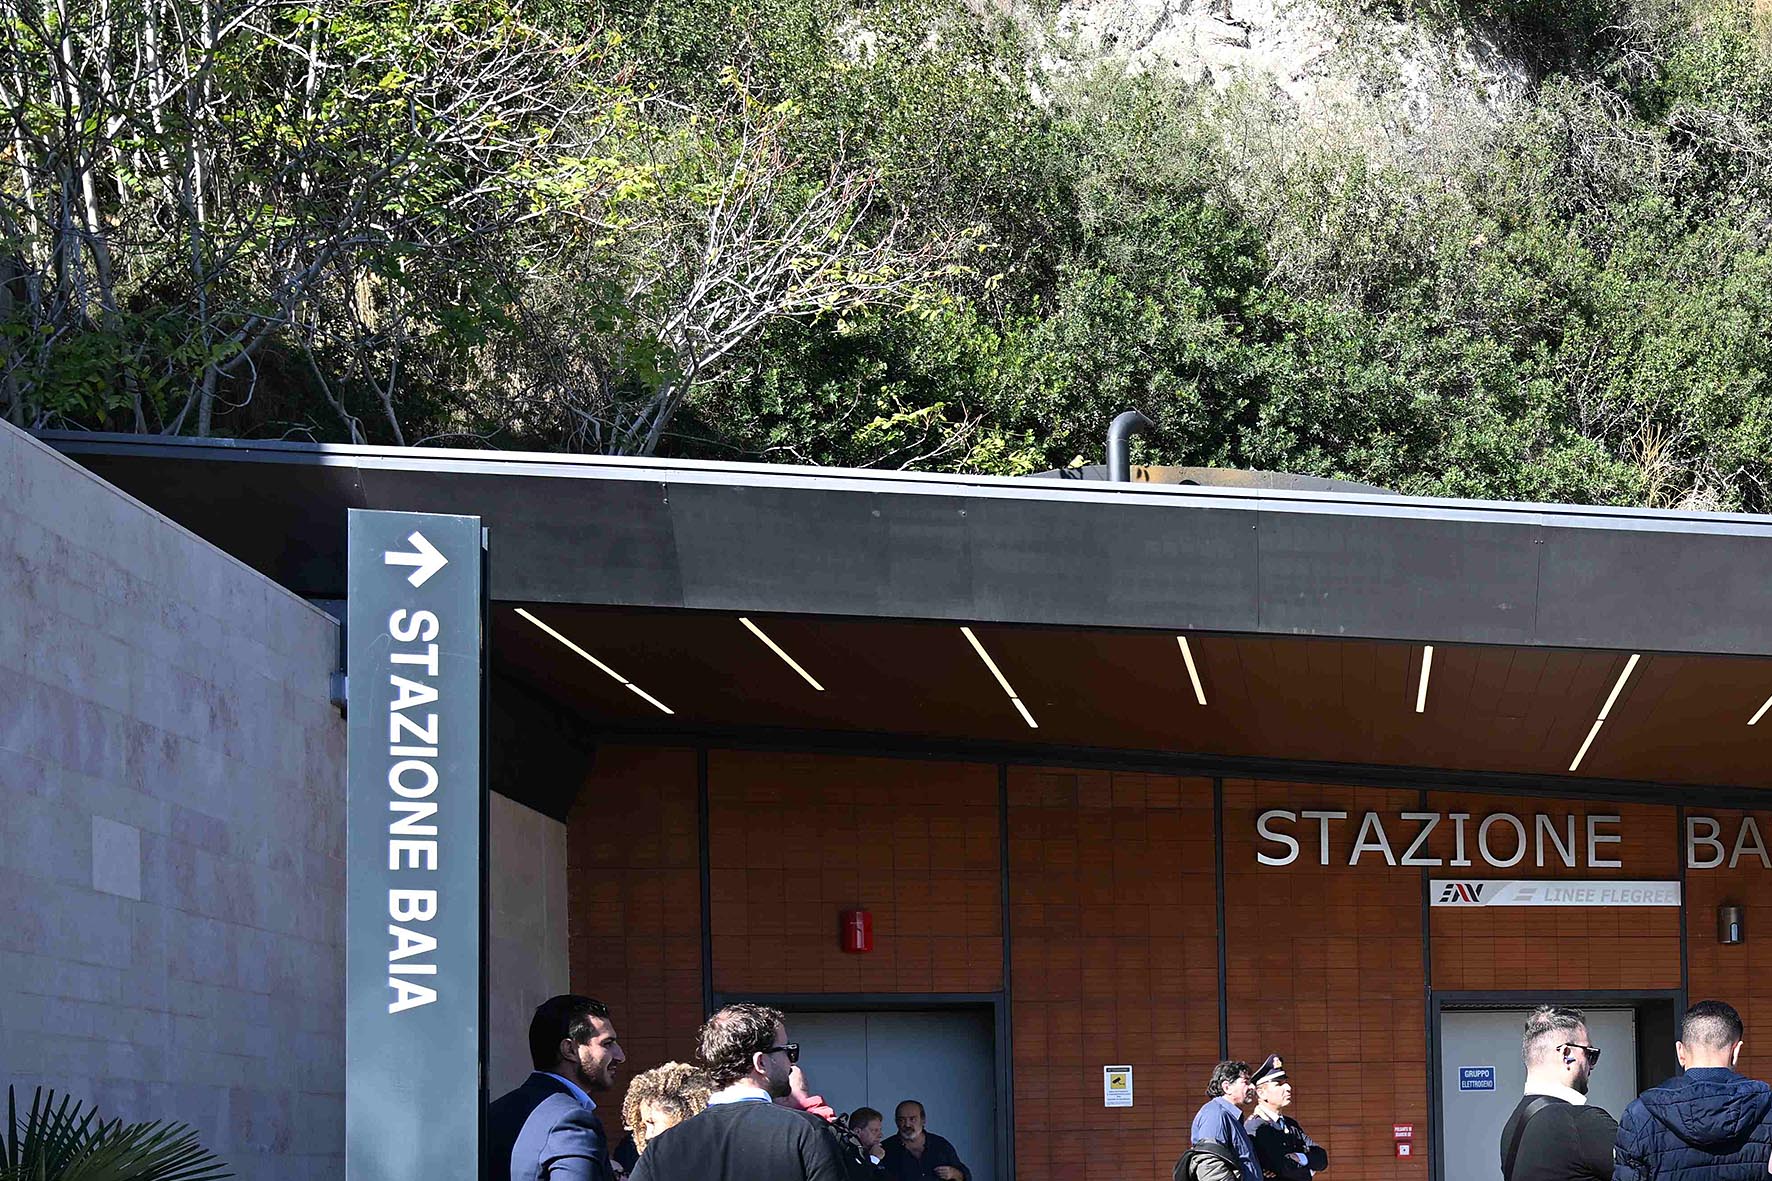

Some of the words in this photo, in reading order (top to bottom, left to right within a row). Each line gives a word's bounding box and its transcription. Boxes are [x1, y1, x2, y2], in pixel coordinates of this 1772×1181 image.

[388, 608, 440, 871] STAZIONE
[1256, 808, 1623, 869] STAZIONE
[1544, 887, 1597, 903] LINEE
[1600, 888, 1675, 904] FLEGREE
[388, 888, 439, 1015] BAIA
[1464, 1069, 1490, 1078] GRUPPO
